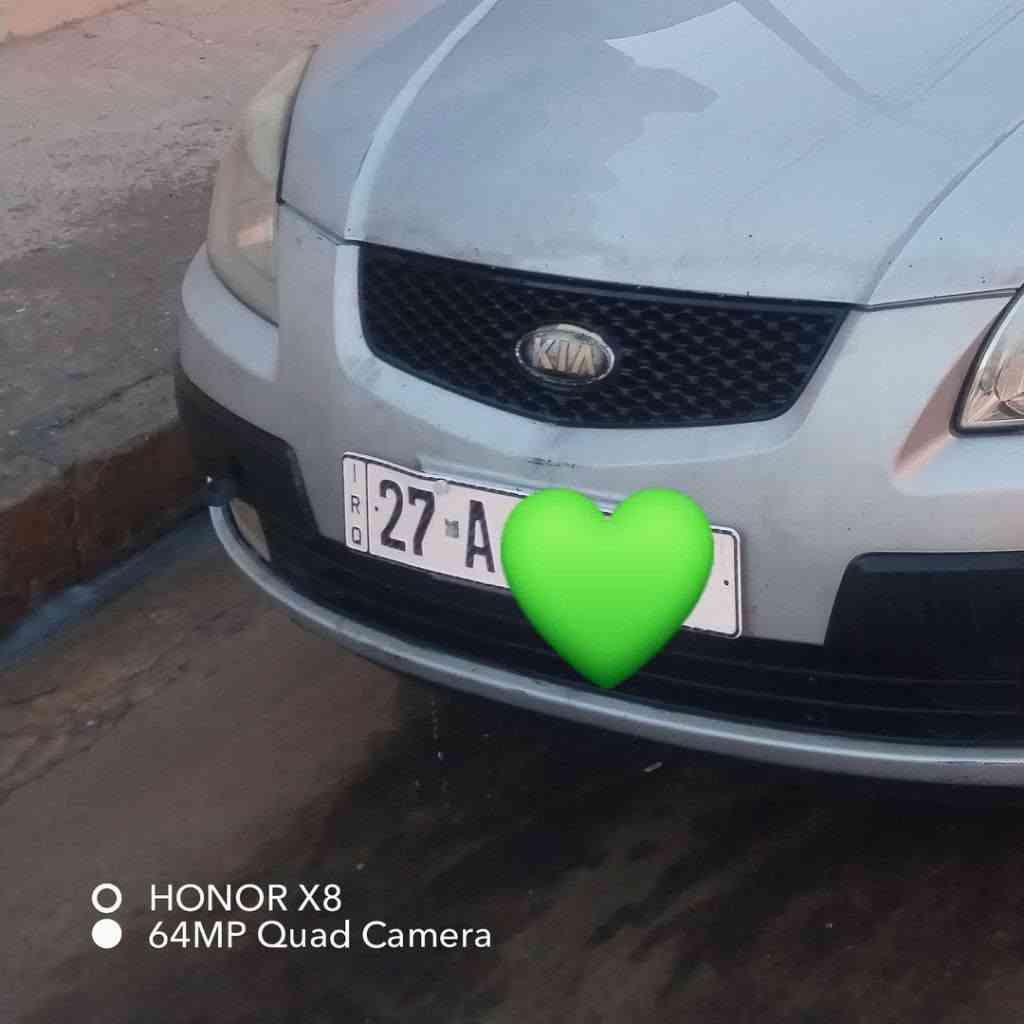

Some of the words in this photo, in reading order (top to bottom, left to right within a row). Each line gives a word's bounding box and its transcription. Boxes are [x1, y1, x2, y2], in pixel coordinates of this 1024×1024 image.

[531, 335, 596, 376] KIA
[379, 479, 436, 557] 27
[465, 499, 496, 573] A
